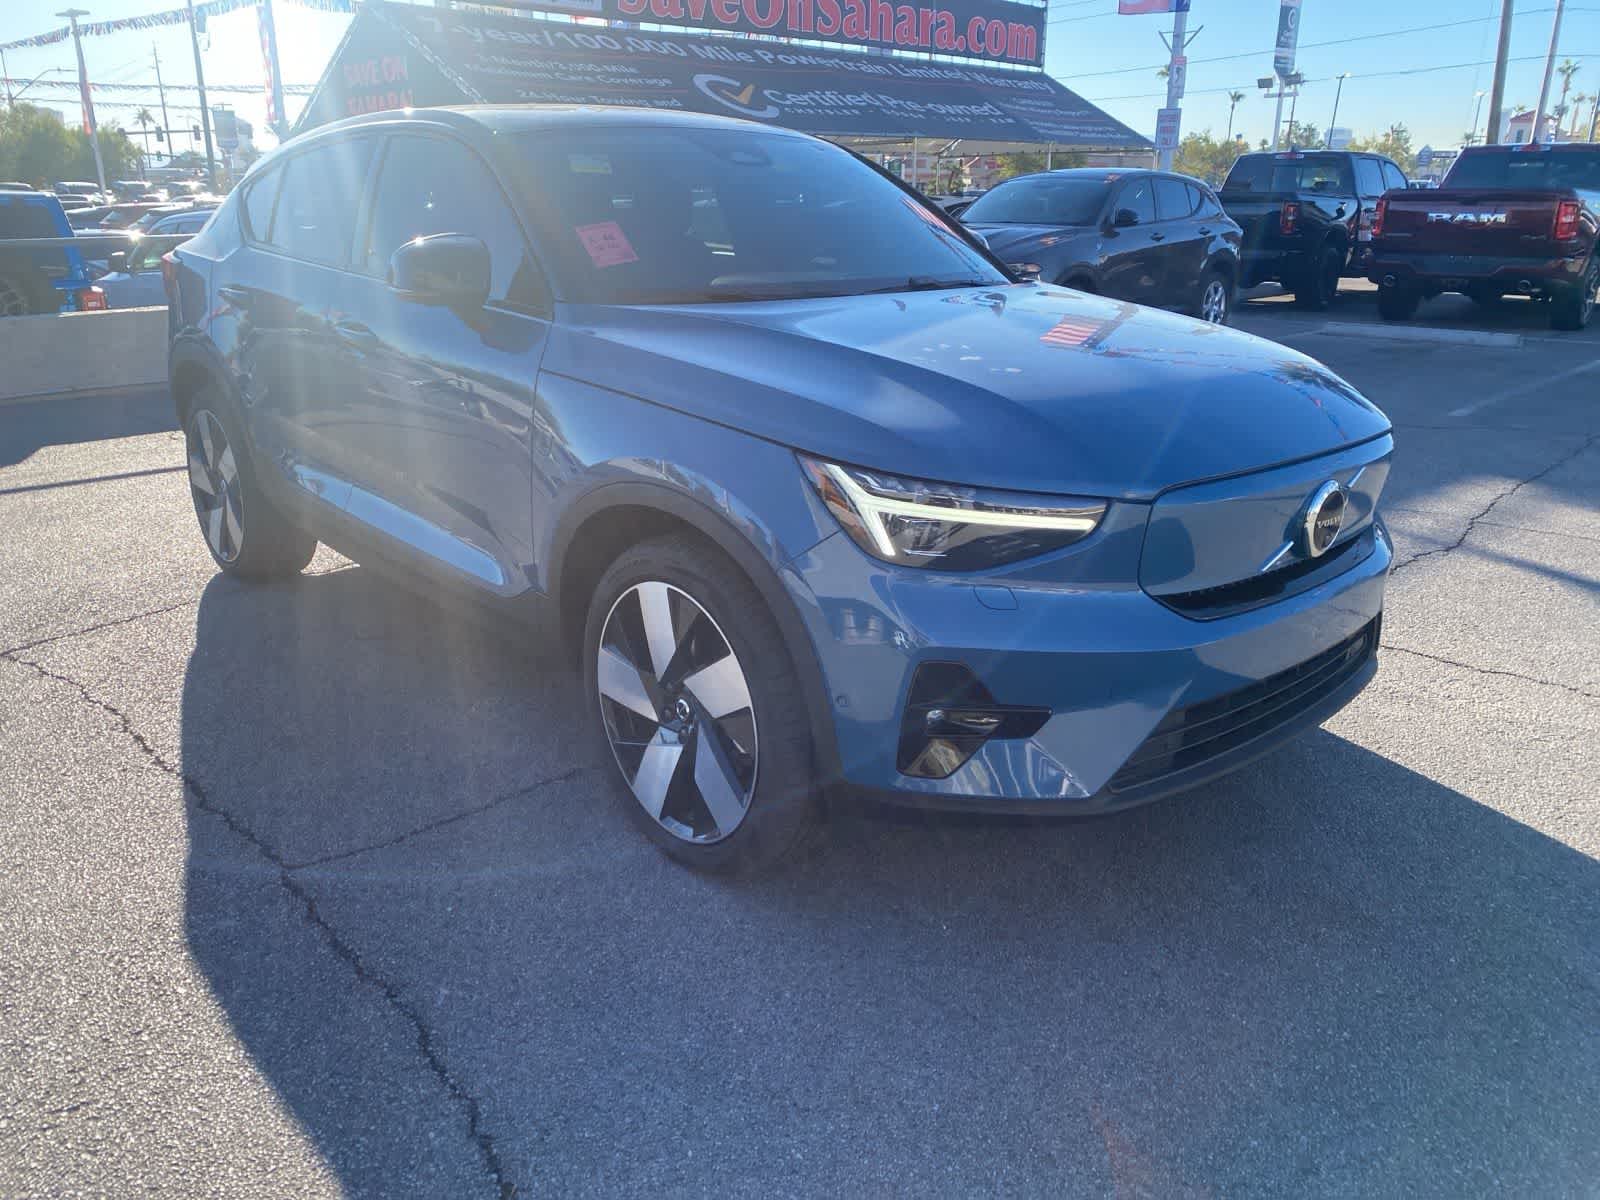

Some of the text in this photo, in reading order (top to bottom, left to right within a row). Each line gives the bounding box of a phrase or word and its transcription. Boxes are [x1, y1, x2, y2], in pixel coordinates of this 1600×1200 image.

[617, 0, 1036, 61] veOnSahara.com
[687, 43, 757, 64] Mile
[751, 48, 890, 75] Powertrain
[888, 63, 969, 81] Limited
[962, 70, 1056, 94] Warranty
[762, 89, 881, 107] Certified
[1426, 211, 1508, 224] RAM
[1316, 515, 1341, 529] VOLVO
